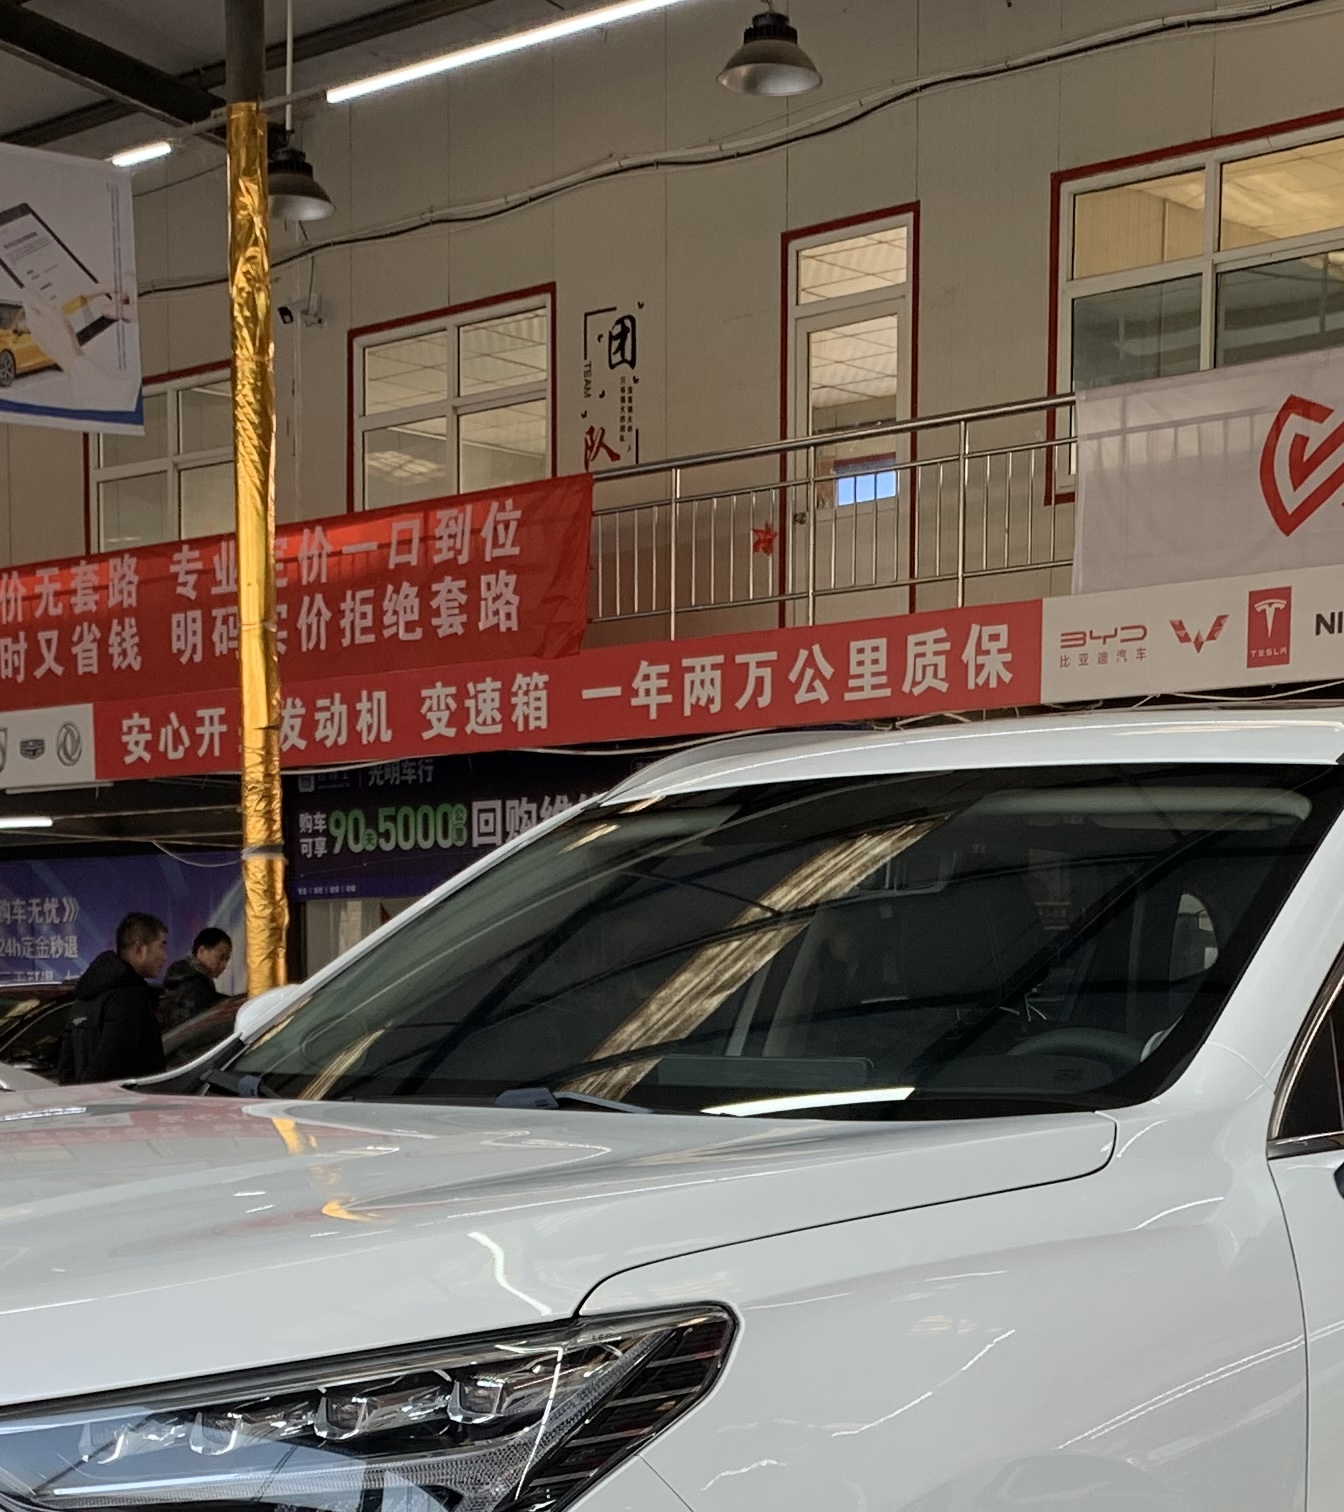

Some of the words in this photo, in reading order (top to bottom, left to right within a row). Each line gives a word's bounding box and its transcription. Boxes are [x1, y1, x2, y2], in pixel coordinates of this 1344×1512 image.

[584, 361, 592, 399] TEAM
[1060, 624, 1148, 649] BYD
[1059, 647, 1148, 668] 比亚迪汽车
[1251, 647, 1288, 659] TESLA
[121, 706, 242, 765] 安心开
[279, 690, 392, 752] 发动机
[420, 671, 550, 742] 变速箱
[581, 624, 1014, 720] 一年两万公里质保
[368, 759, 435, 786] 光明车行
[299, 811, 327, 833] 购车
[300, 838, 328, 858] 可享
